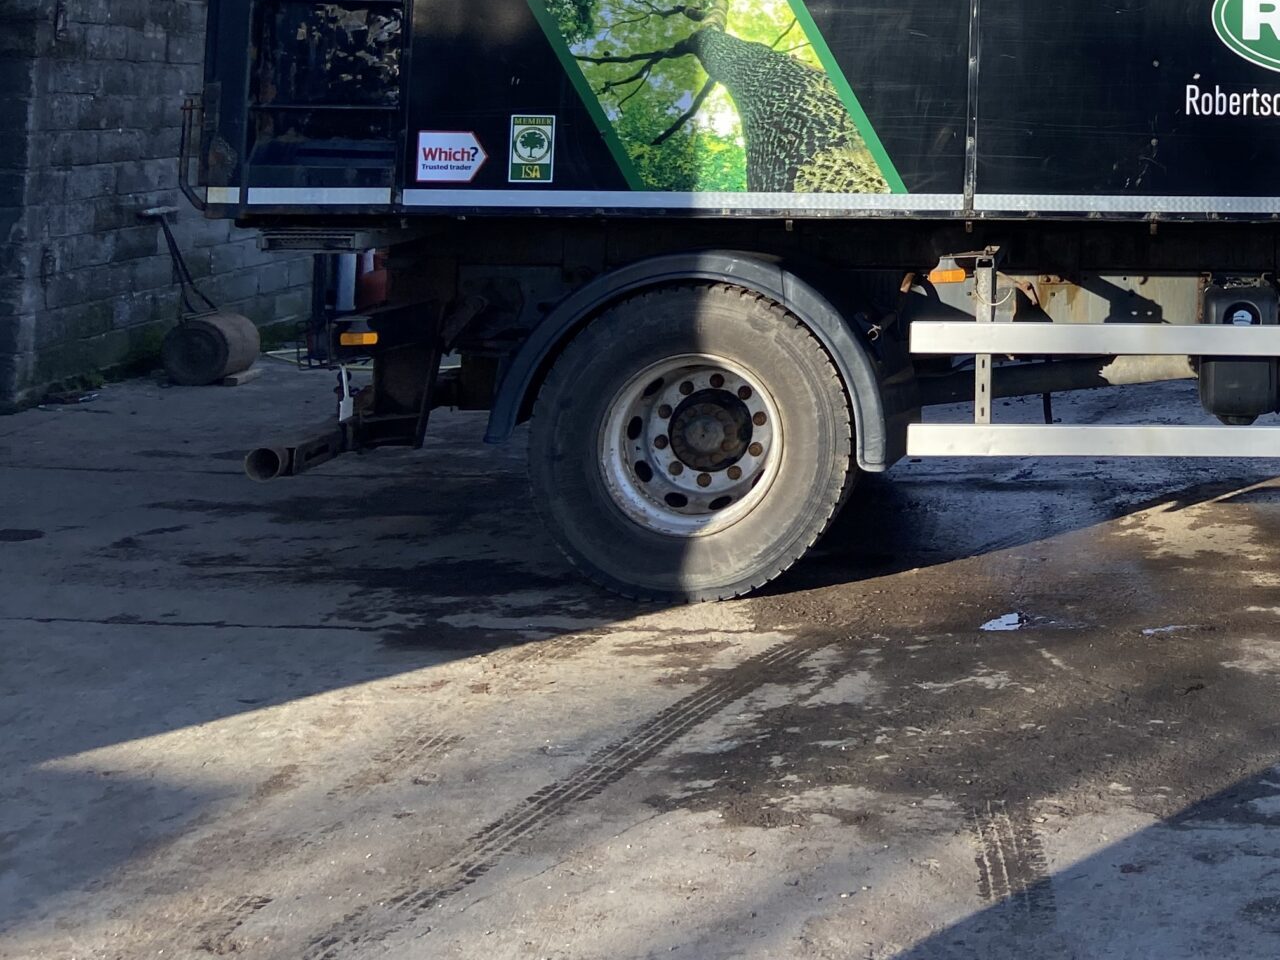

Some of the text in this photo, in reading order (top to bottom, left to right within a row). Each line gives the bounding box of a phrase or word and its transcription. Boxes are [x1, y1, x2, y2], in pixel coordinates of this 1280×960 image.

[514, 117, 553, 126] MEMBER
[422, 146, 479, 162] Which?
[421, 163, 472, 172] Trusted trader
[521, 165, 541, 179] ISA
